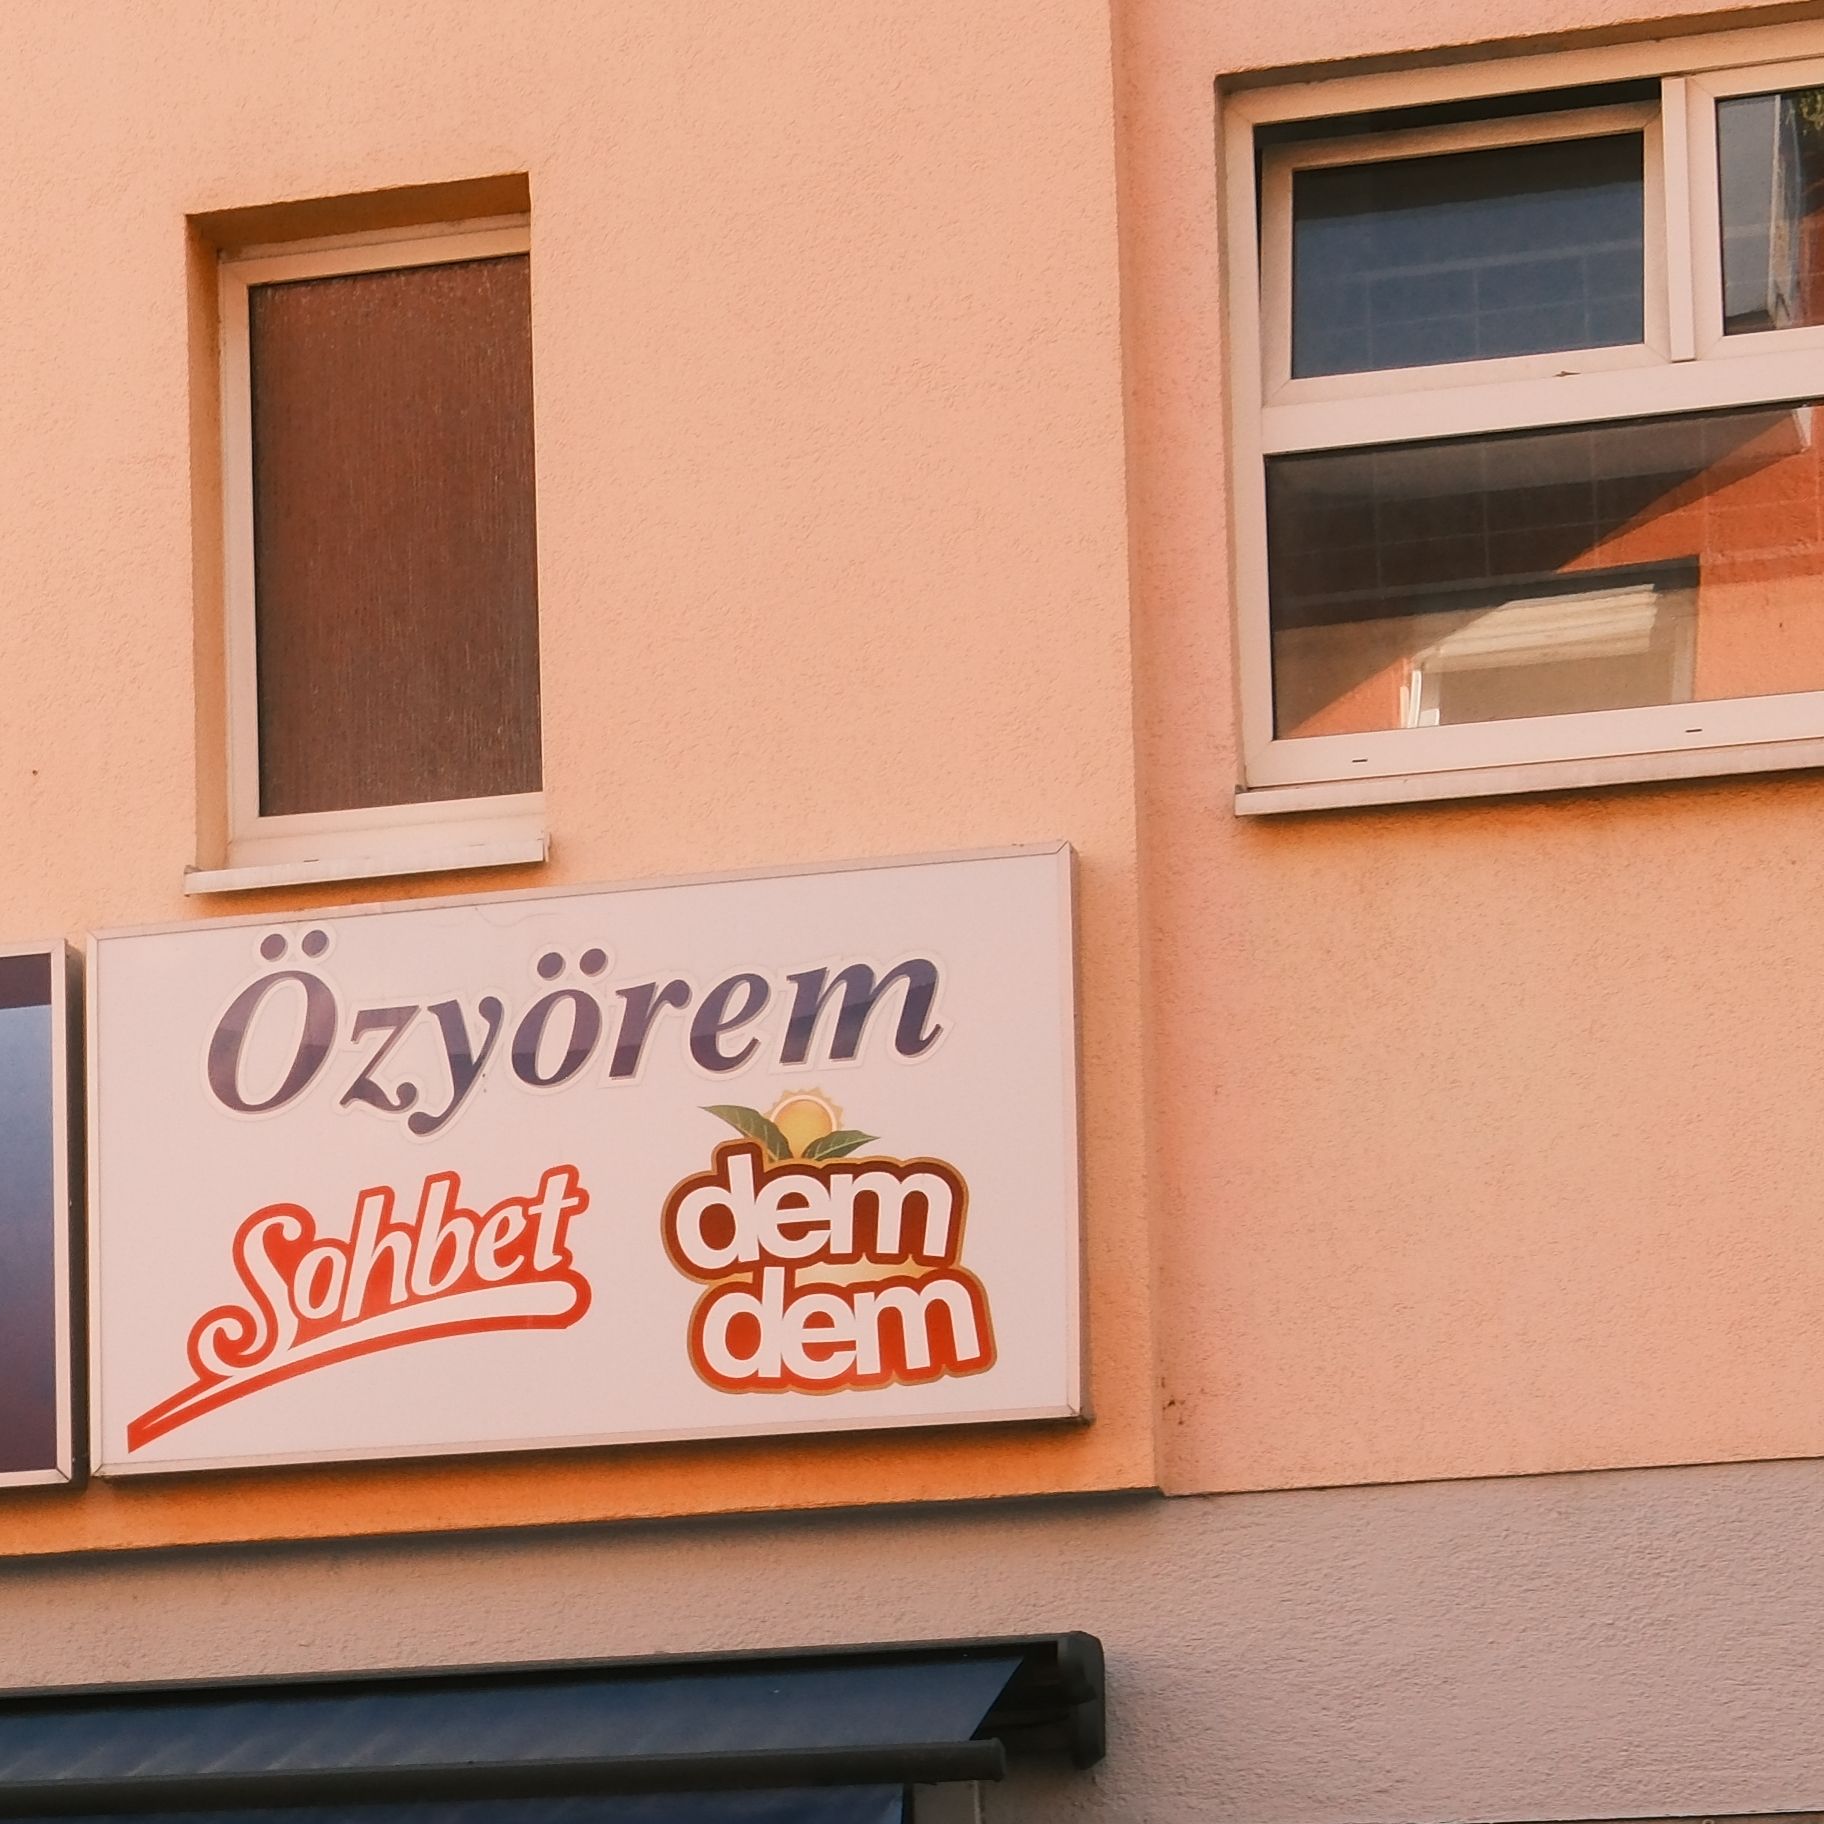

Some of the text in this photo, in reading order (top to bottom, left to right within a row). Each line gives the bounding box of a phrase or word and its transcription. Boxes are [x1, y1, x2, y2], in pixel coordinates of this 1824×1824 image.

[207, 929, 943, 1138] Özyörem
[192, 1168, 590, 1376] Sohbet
[676, 1155, 956, 1264] dem
[702, 1277, 984, 1381] dem
